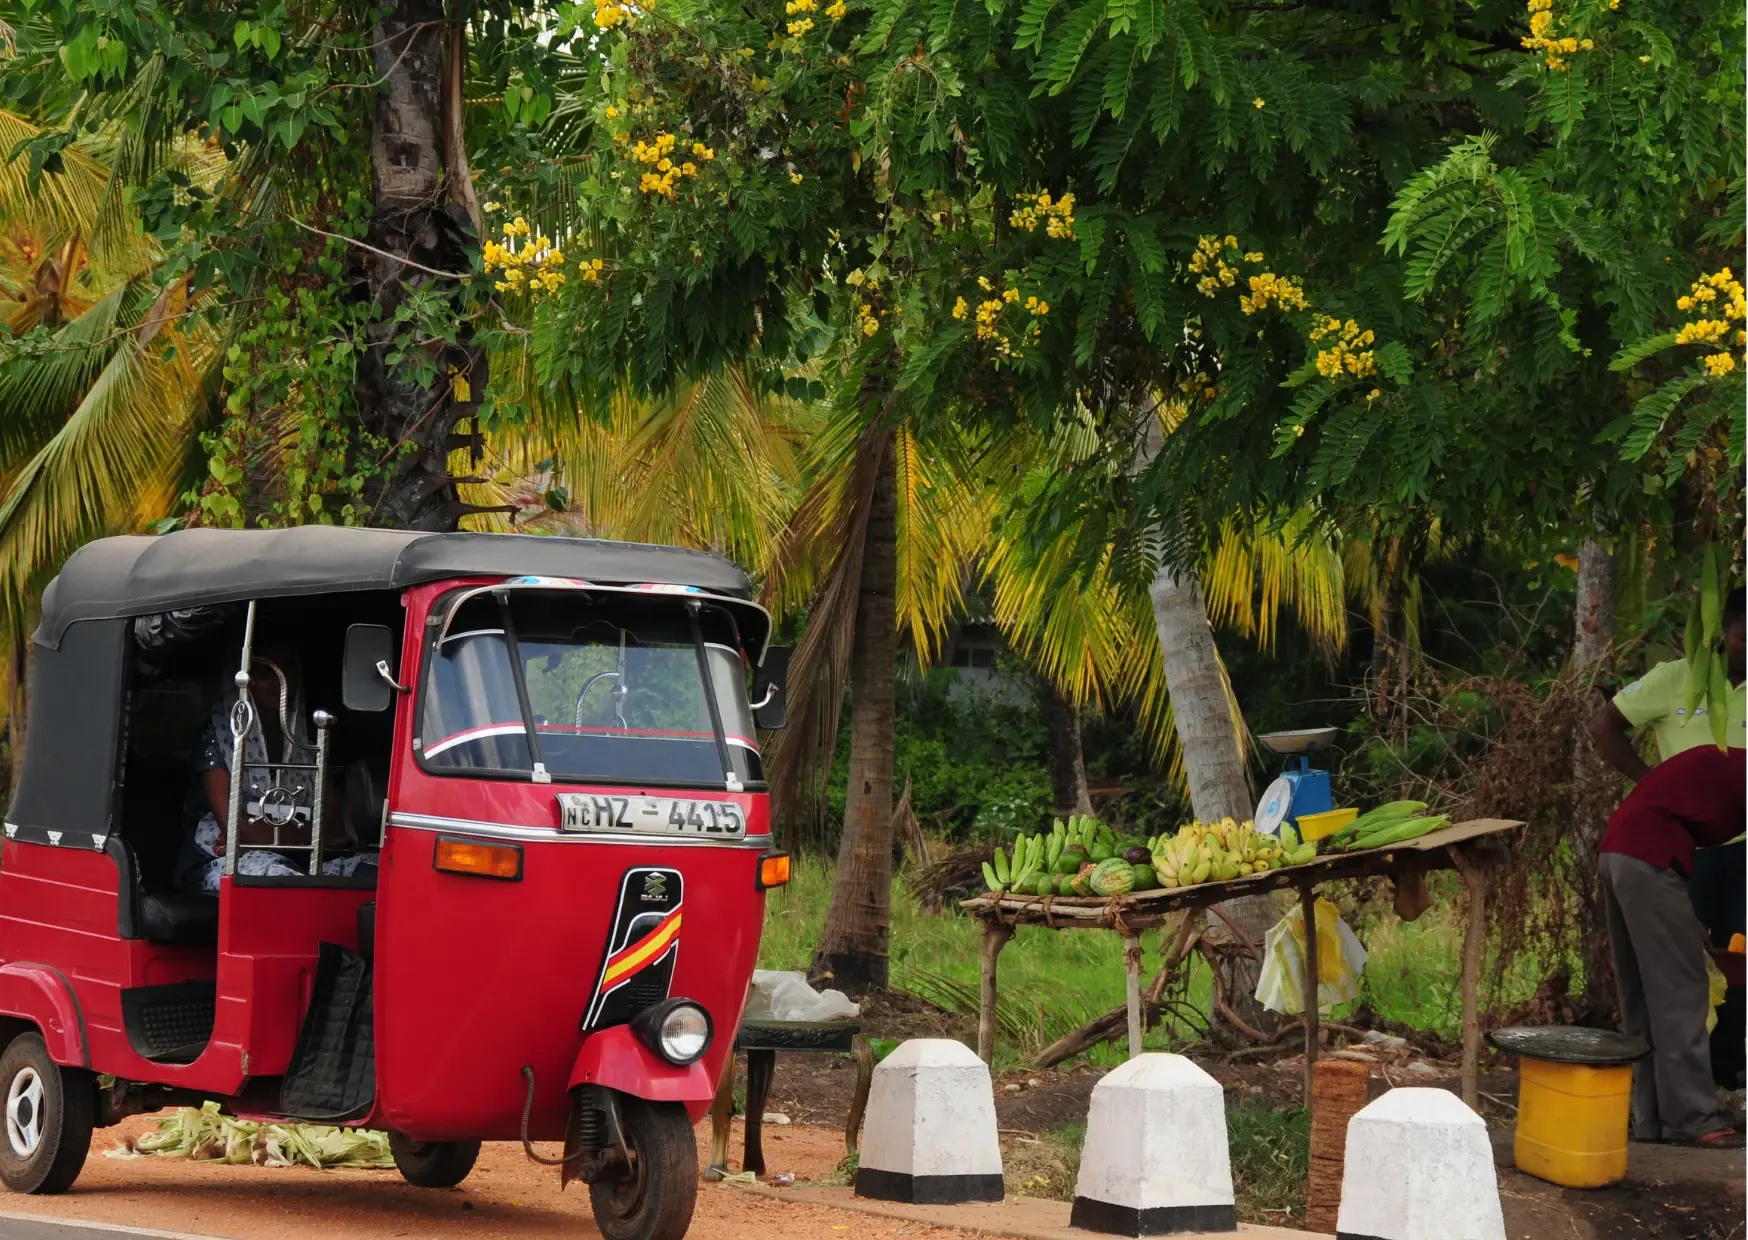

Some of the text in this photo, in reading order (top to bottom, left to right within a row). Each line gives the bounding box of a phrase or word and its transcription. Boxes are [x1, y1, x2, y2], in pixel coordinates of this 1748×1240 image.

[567, 807, 590, 826] NC
[591, 796, 634, 828] HZ
[669, 801, 741, 833] 4415
